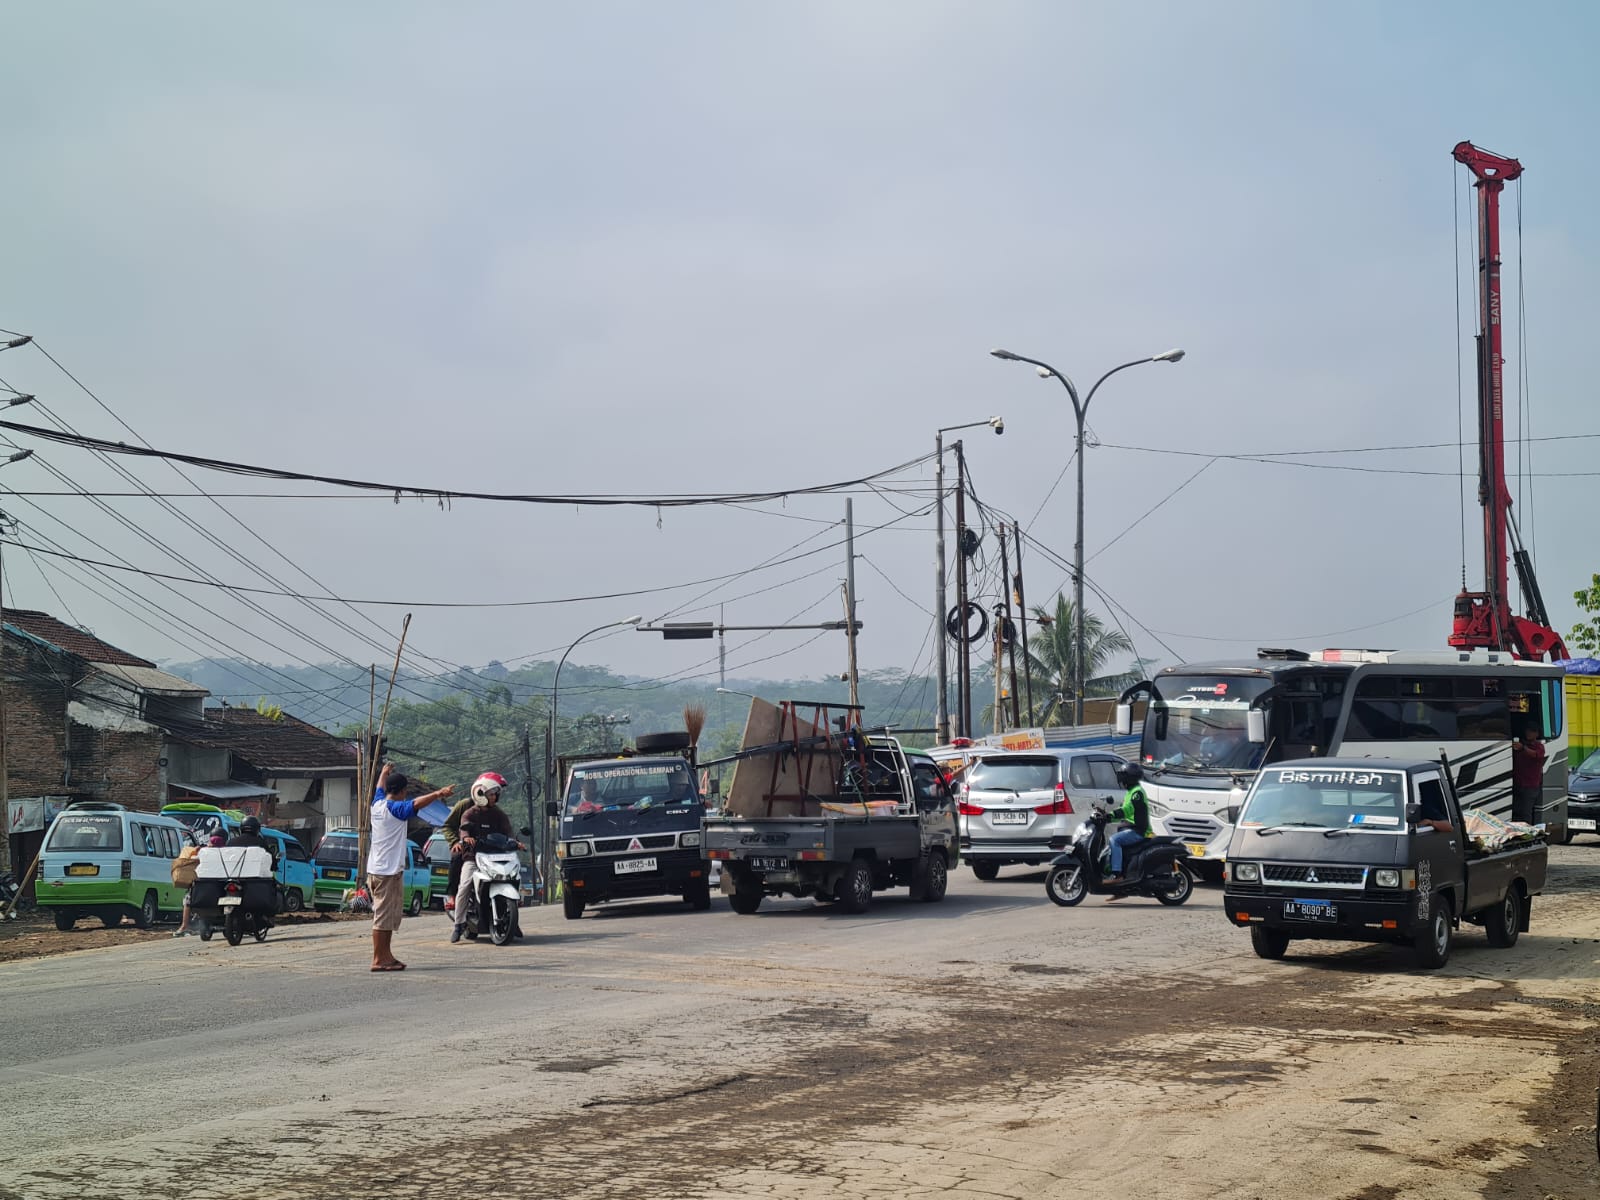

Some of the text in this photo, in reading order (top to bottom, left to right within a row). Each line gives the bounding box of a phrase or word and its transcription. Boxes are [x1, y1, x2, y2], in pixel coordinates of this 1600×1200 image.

[1490, 290, 1500, 325] SANY
[584, 771, 603, 780] MOBIL
[604, 768, 647, 778] OPERASIONAL
[1279, 770, 1383, 786] Bismillah
[616, 862, 625, 870] AA
[1285, 903, 1337, 917] AA 8090 BE
